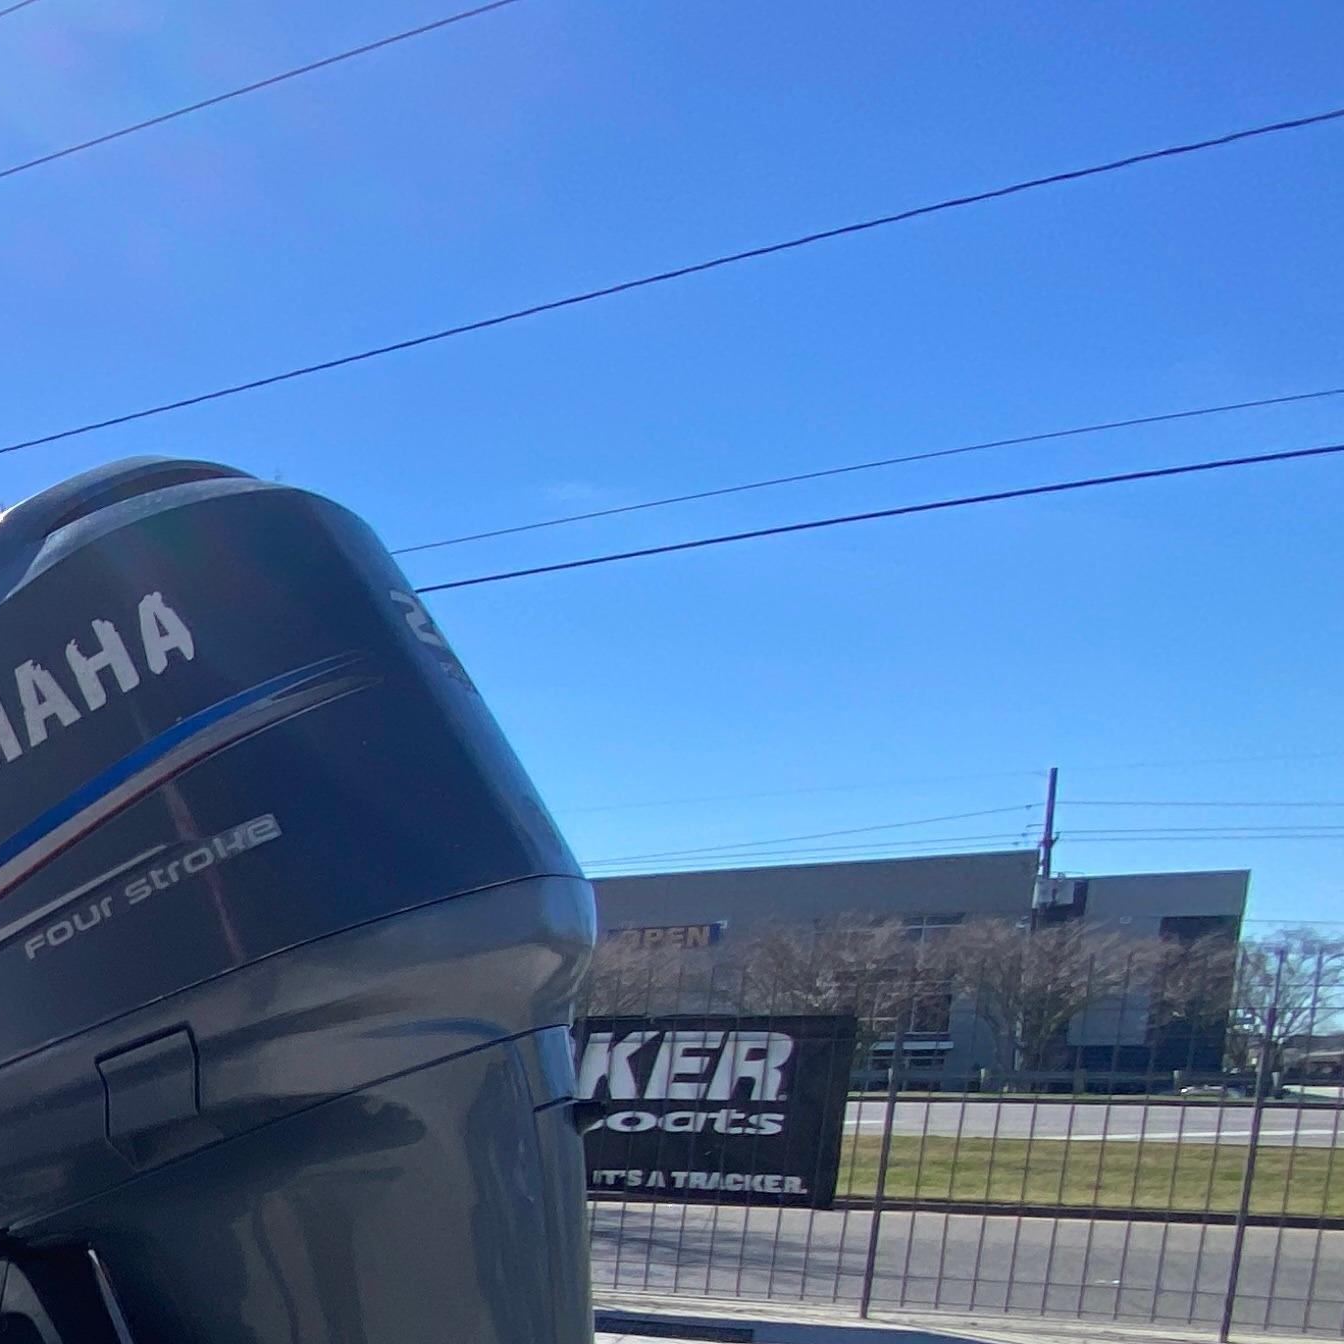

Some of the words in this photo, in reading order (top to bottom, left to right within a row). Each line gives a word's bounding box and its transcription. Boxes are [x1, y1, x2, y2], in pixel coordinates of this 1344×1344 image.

[570, 1030, 794, 1101] KER
[584, 1108, 785, 1135] oats
[645, 1171, 666, 1188] A
